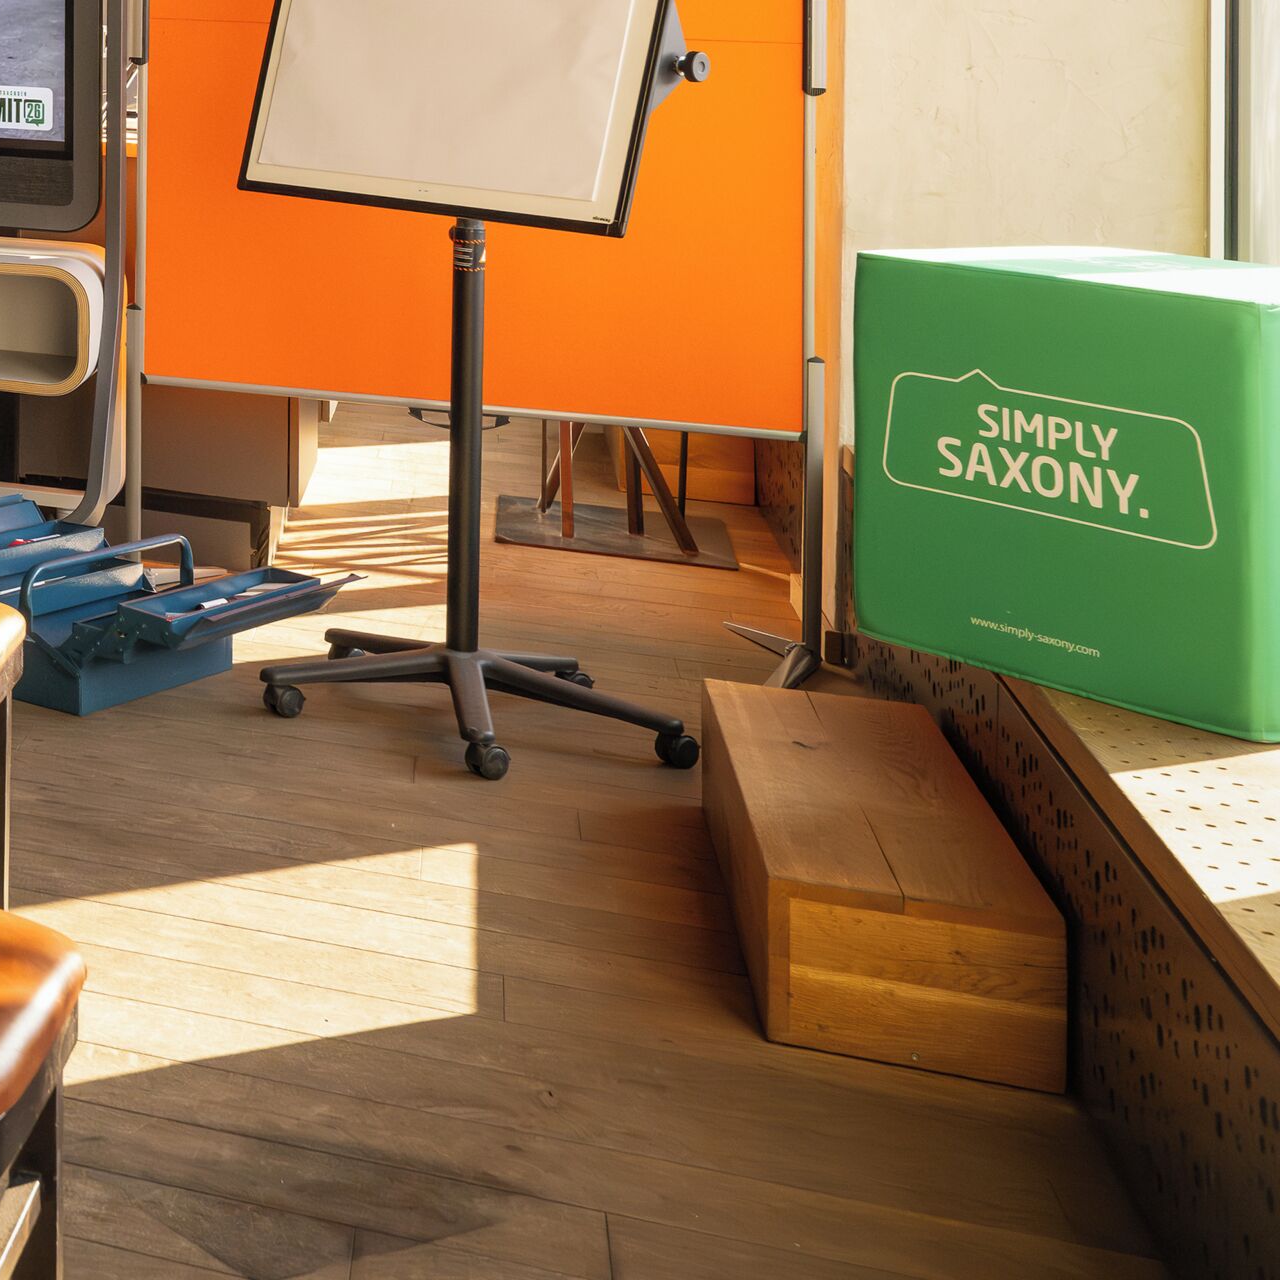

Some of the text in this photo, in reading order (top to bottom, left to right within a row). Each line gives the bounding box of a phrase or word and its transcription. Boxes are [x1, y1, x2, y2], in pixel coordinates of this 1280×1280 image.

[26, 103, 41, 119] 26
[977, 403, 1118, 462] SIMPLY
[937, 435, 1150, 519] SAXONY.
[970, 616, 1101, 658] www.simply-saxony.com
